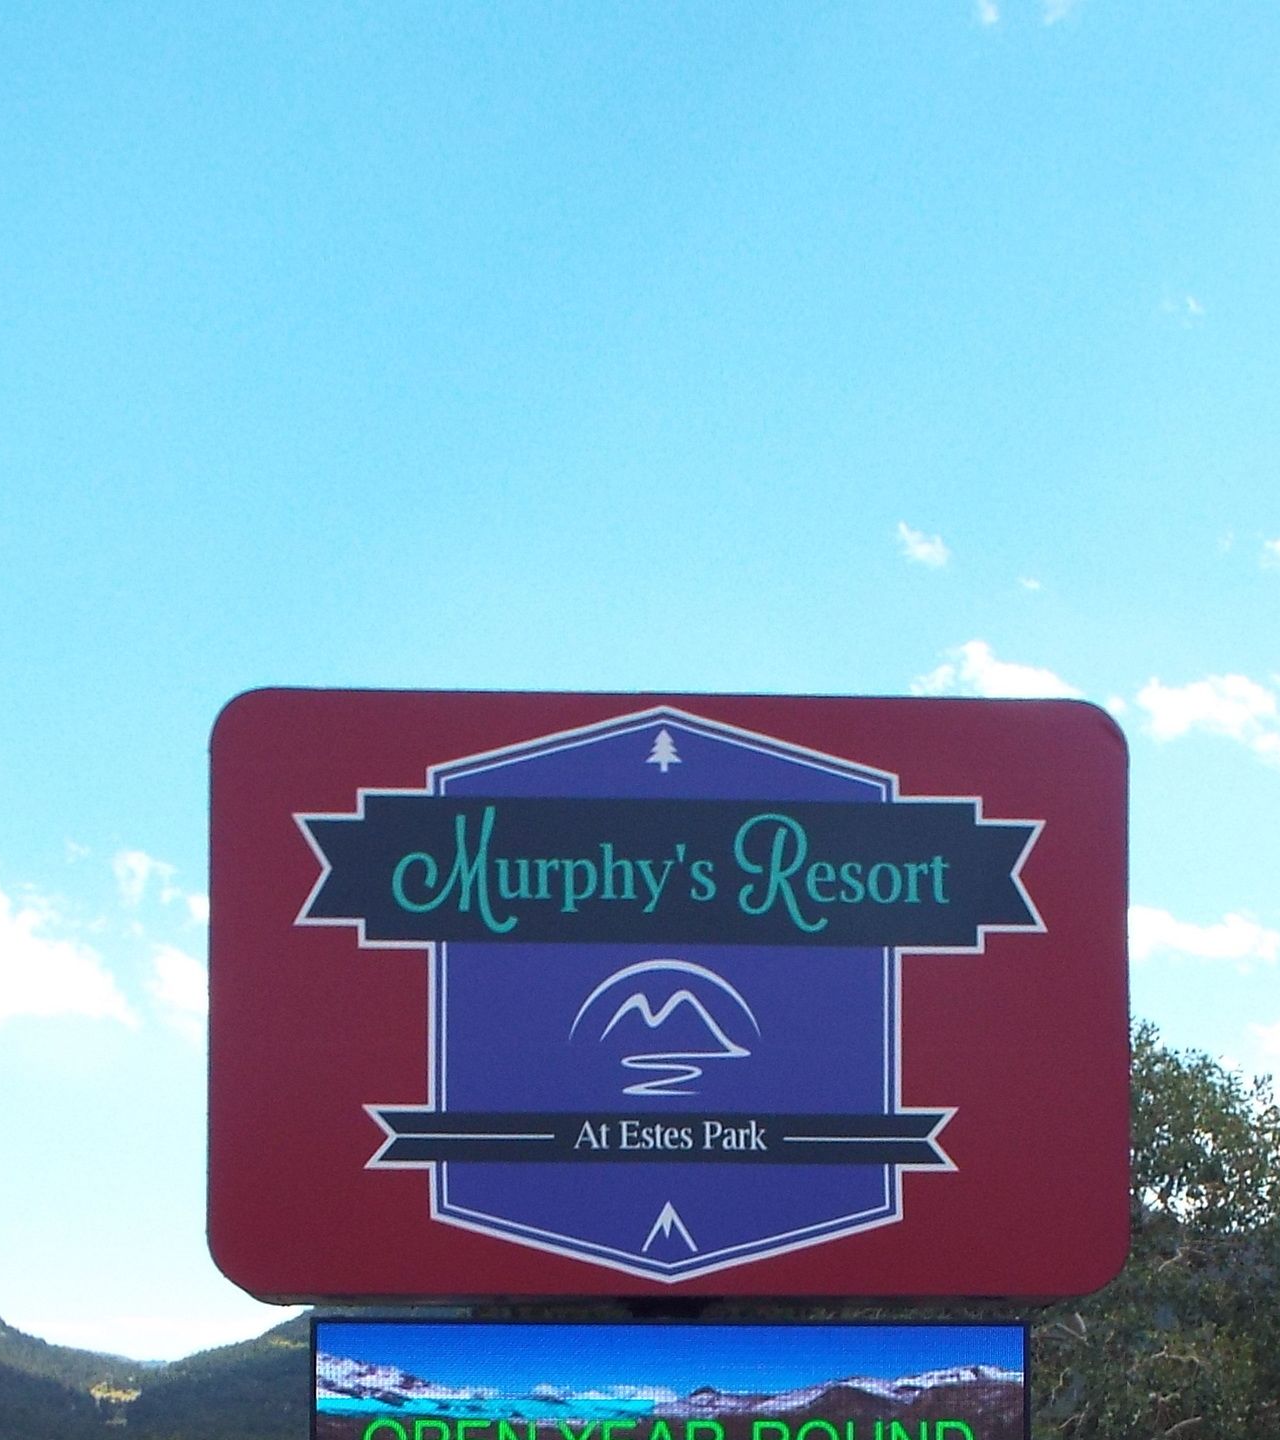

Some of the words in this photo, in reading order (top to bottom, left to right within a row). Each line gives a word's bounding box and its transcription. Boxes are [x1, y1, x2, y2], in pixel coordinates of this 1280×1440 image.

[391, 805, 715, 934] Murphy's
[733, 811, 950, 933] Resort
[573, 1120, 610, 1150] At
[620, 1120, 694, 1151] Estes
[702, 1120, 768, 1152] Park
